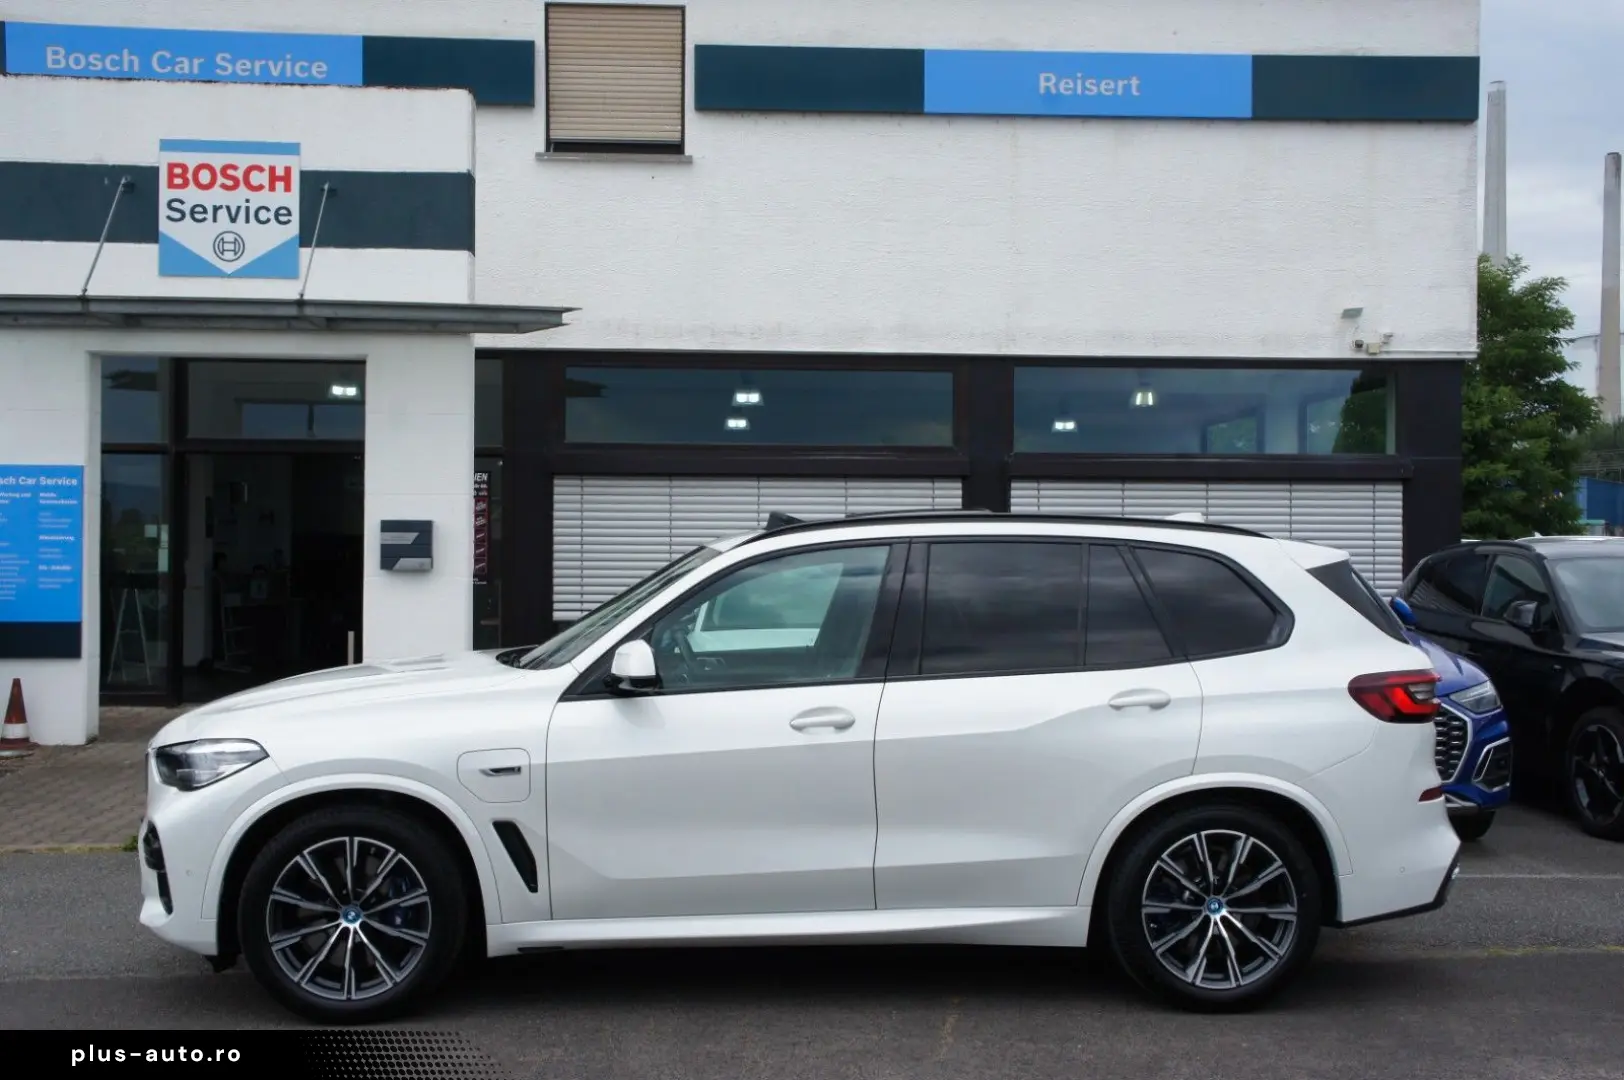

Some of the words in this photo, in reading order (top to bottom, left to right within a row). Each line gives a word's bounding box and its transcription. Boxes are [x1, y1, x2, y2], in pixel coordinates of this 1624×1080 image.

[45, 46, 140, 73] Bosch
[151, 50, 205, 75] Car
[215, 53, 328, 79] Service
[1038, 72, 1141, 97] Reisert
[166, 162, 293, 193] BOSCH
[165, 198, 293, 226] Service
[18, 476, 37, 485] Car
[39, 476, 78, 486] Service
